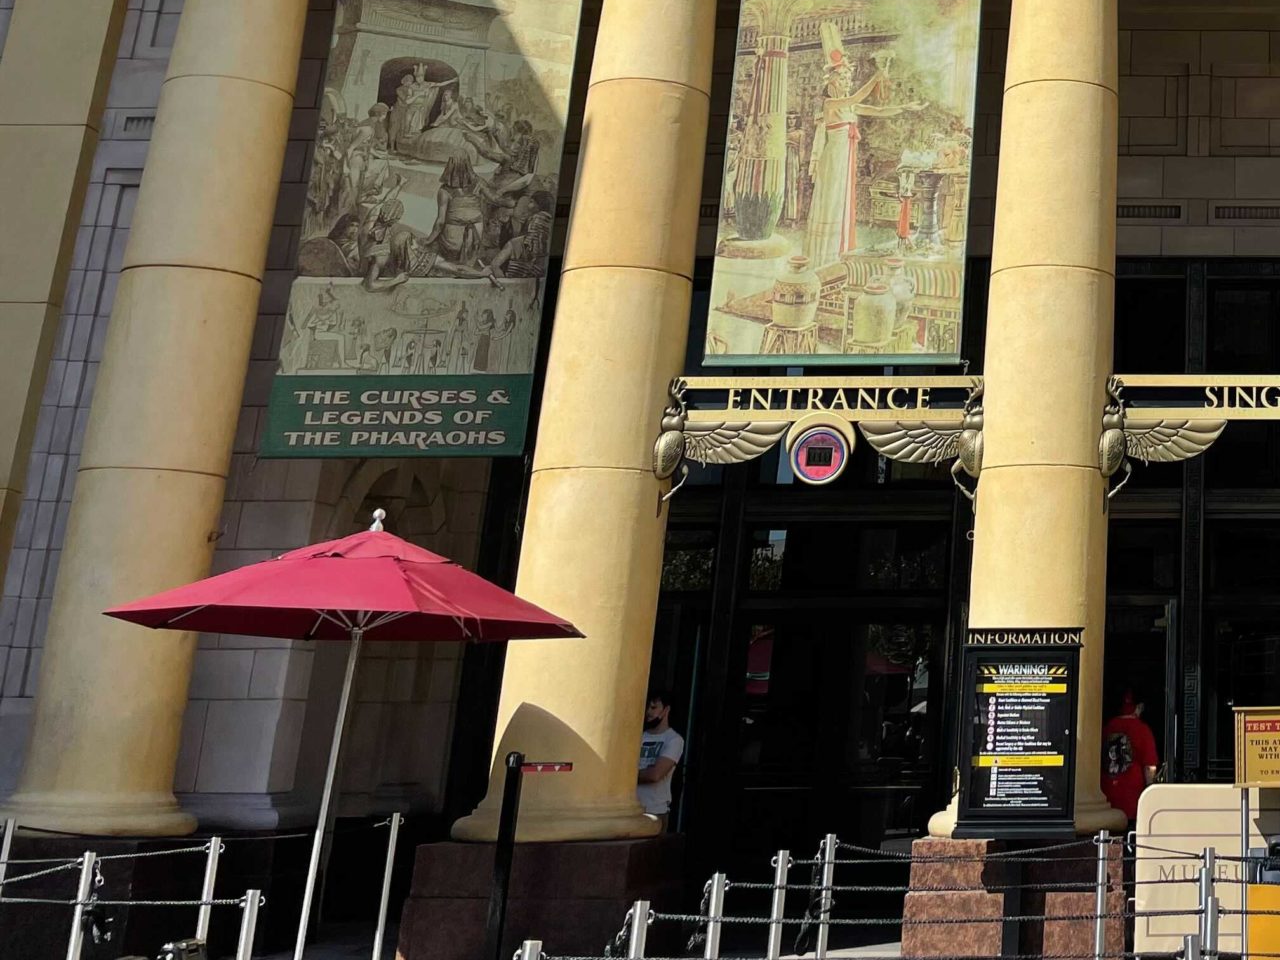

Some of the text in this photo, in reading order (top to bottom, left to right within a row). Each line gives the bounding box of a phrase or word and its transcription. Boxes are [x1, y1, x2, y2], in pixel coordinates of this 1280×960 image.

[293, 389, 511, 409] THE CURSES &
[727, 388, 932, 410] ENTRANCE
[304, 410, 493, 425] LEGENDS OF
[283, 430, 507, 450] THE PHARAOHS
[968, 631, 1080, 645] INFORMATION
[998, 664, 1048, 675] WARNING!
[1247, 723, 1272, 731] TEST
